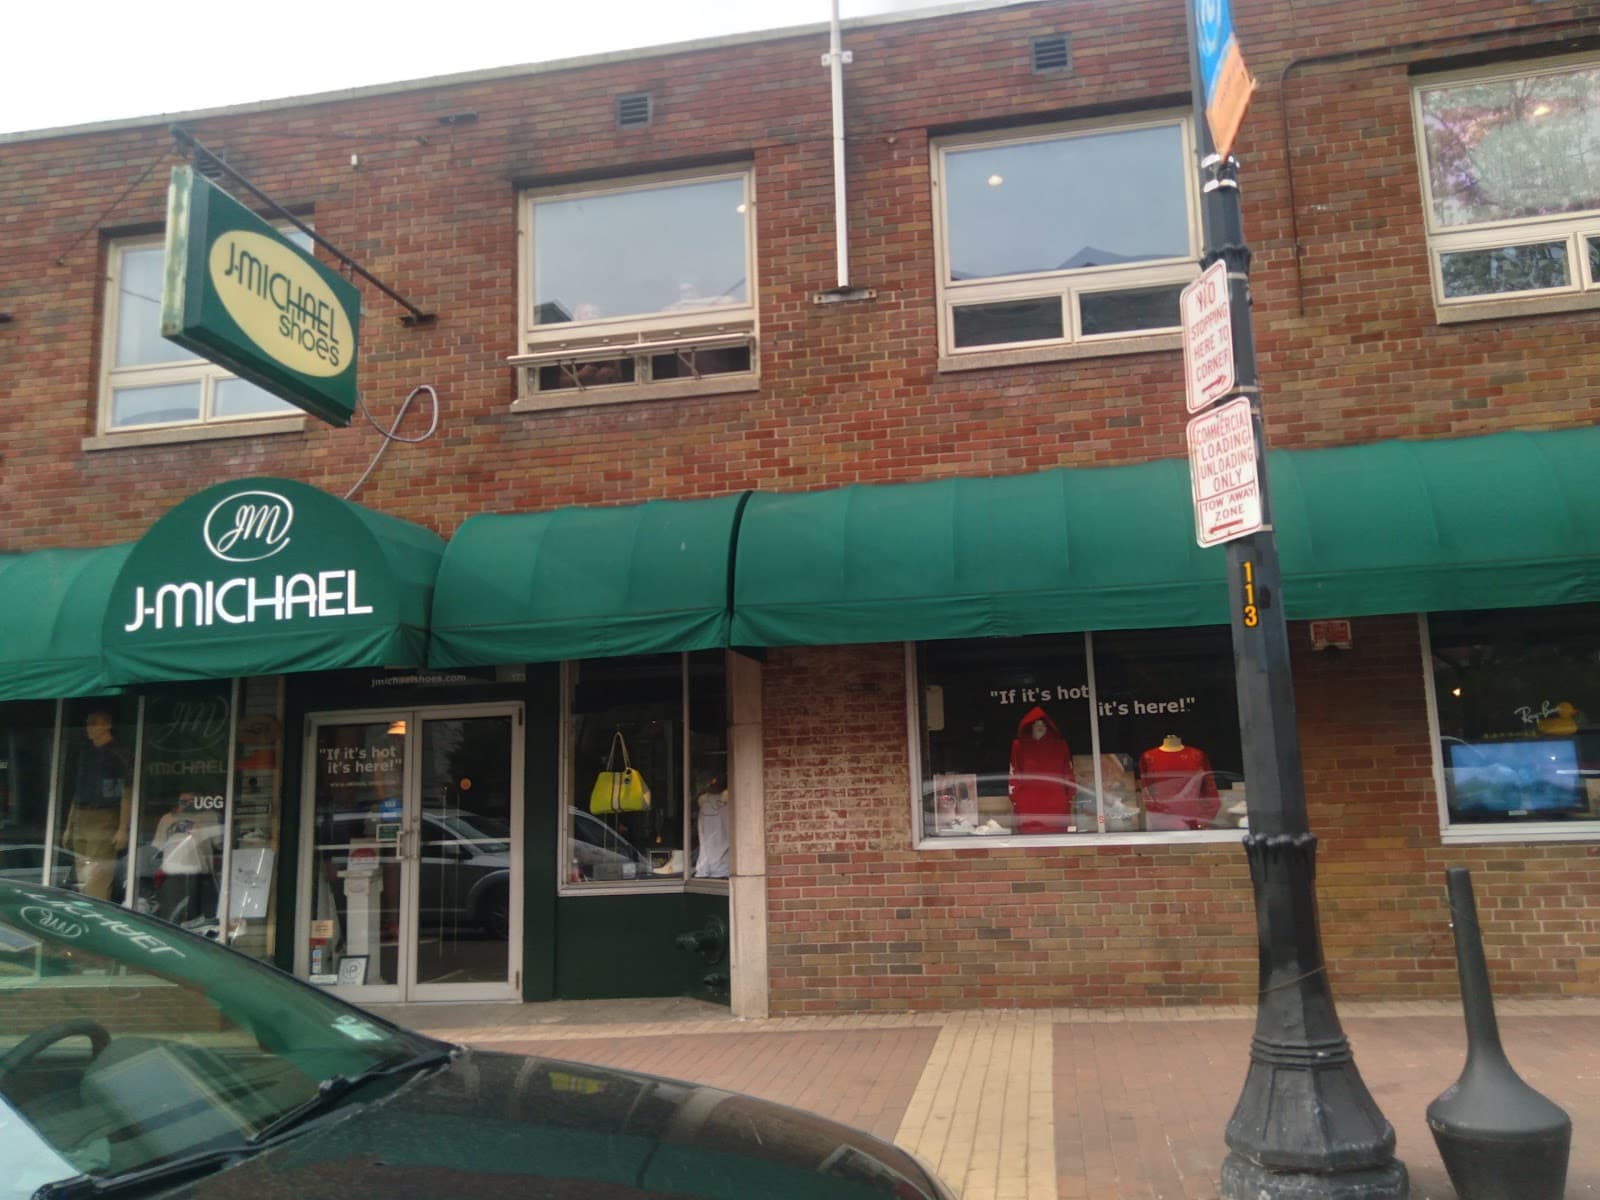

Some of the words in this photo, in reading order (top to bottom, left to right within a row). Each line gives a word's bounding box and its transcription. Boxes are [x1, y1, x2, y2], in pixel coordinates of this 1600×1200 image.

[1195, 281, 1216, 312] NO
[1191, 302, 1228, 341] STOPPING
[279, 308, 339, 367] shoes
[1194, 333, 1216, 360] HERE
[1219, 325, 1229, 343] TO
[1196, 409, 1250, 445] COMMERCIAL
[1201, 429, 1249, 461] LOADING
[1200, 448, 1253, 479] UNLOADING
[1213, 468, 1242, 492] ONLY
[1202, 497, 1224, 513] TOW
[1215, 503, 1244, 522] ZONE
[1021, 687, 1051, 702] it's
[1057, 685, 1089, 700] hot
[1098, 701, 1129, 716] it's
[344, 745, 367, 760] it's
[371, 744, 397, 758] hot
[327, 761, 350, 774] it's
[194, 796, 224, 809] UGG
